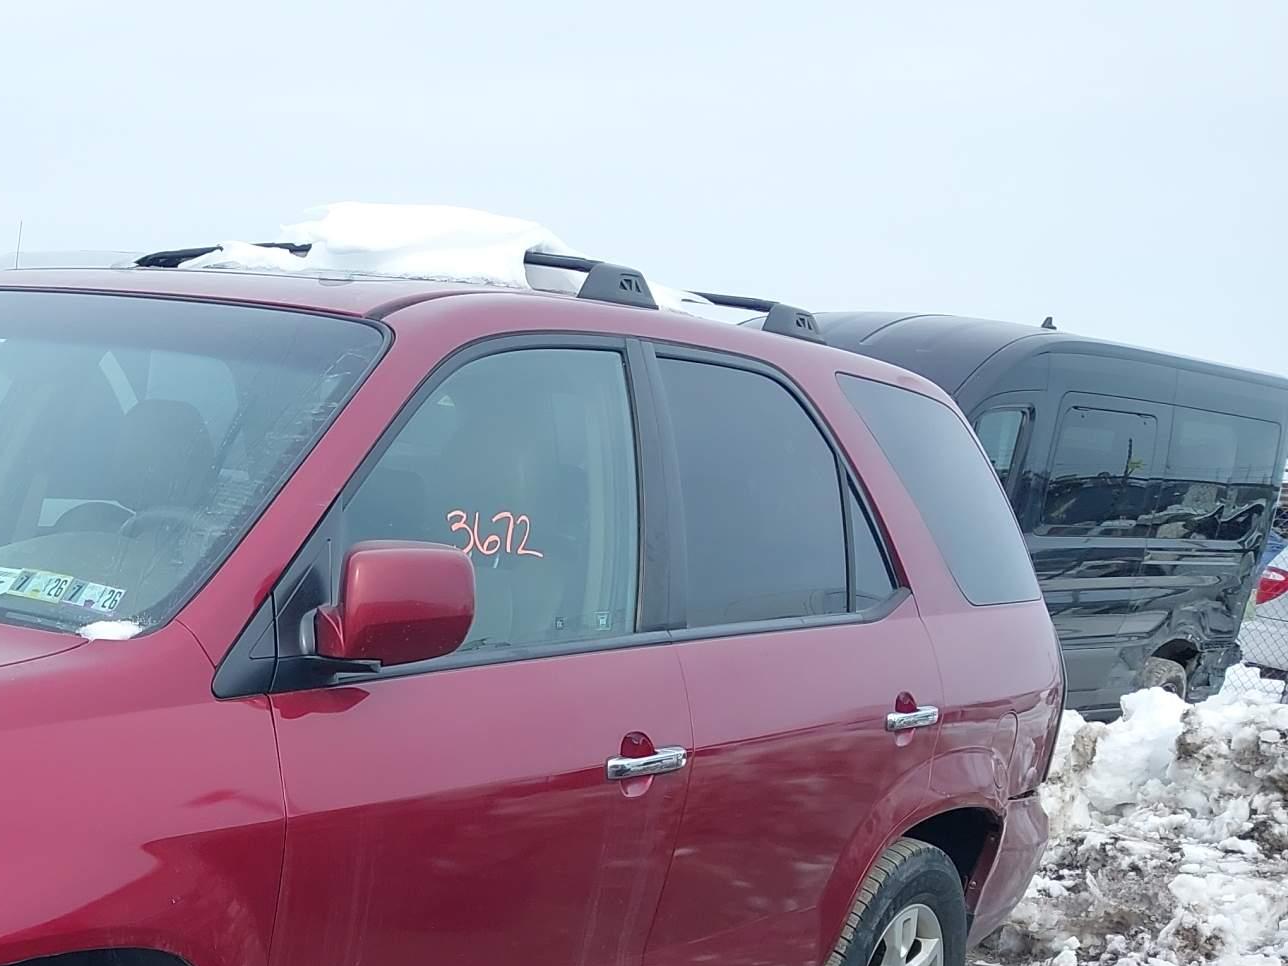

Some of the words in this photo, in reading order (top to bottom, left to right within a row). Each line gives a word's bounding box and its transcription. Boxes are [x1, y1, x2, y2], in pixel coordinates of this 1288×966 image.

[447, 509, 544, 558] 3672
[15, 575, 30, 591] 7
[46, 577, 69, 598] 26
[100, 589, 123, 611] 26
